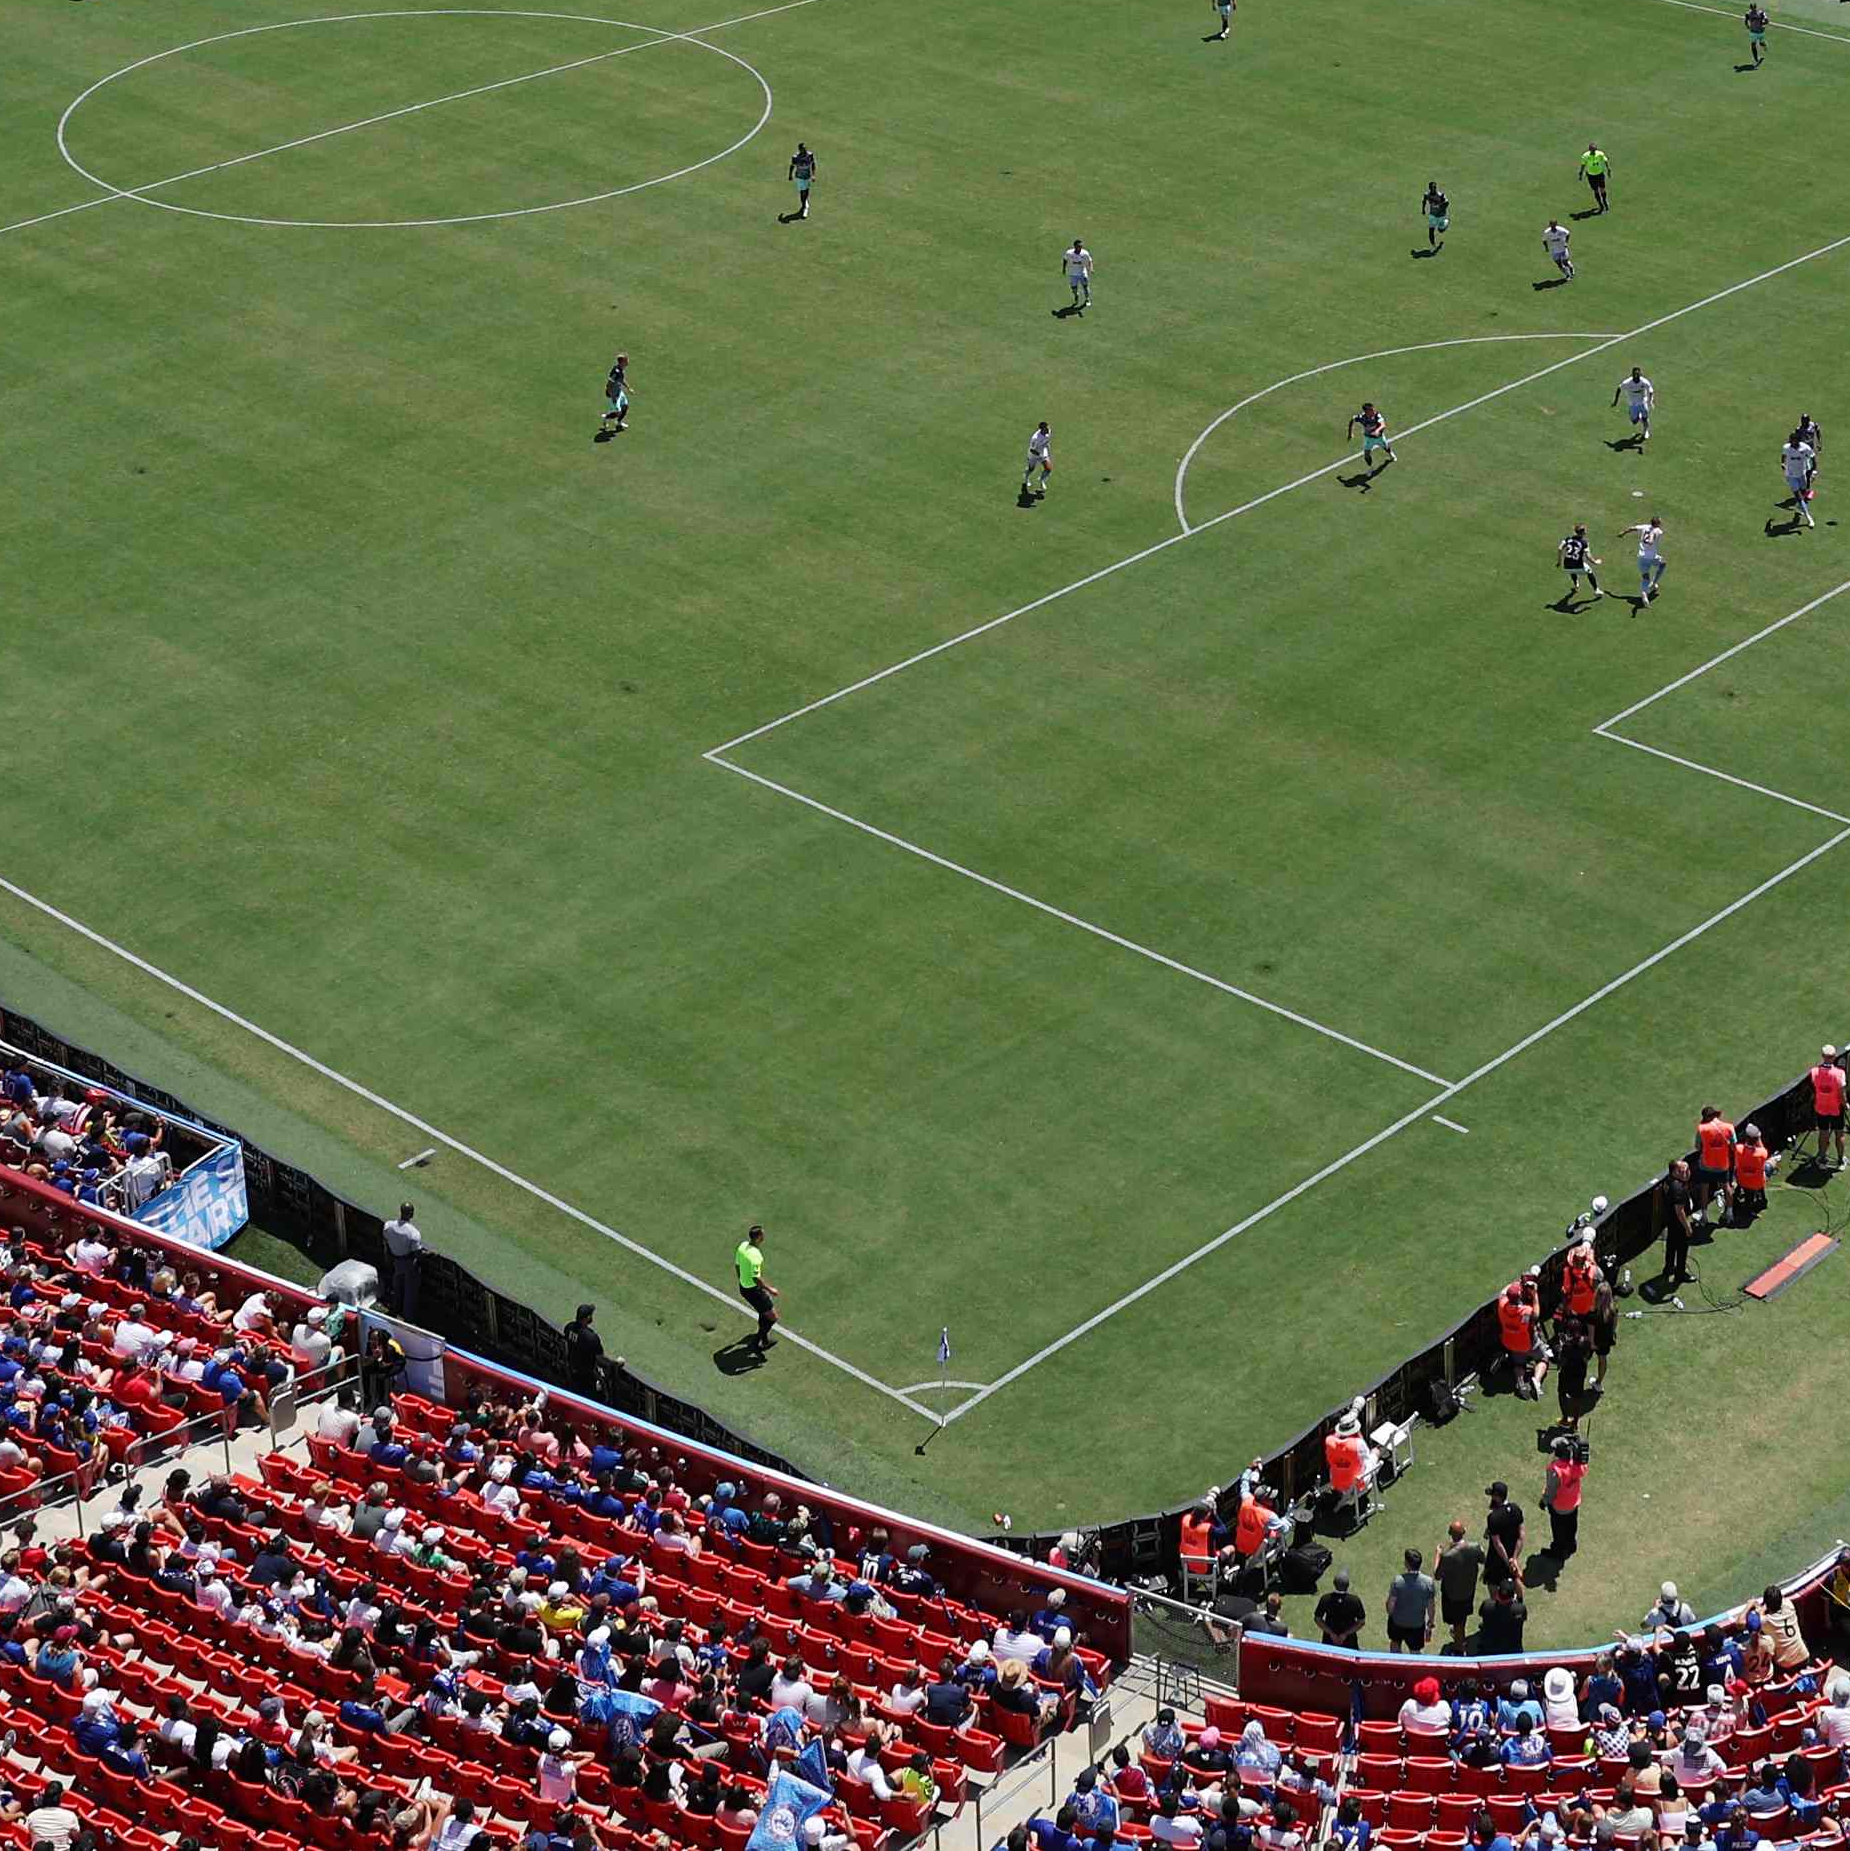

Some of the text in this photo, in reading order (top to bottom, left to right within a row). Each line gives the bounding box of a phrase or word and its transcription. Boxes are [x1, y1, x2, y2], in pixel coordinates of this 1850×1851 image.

[862, 1561, 880, 1582] 10
[1784, 1618, 1797, 1638] 6
[1675, 1664, 1701, 1691] 22
[1458, 1706, 1484, 1731] 10
